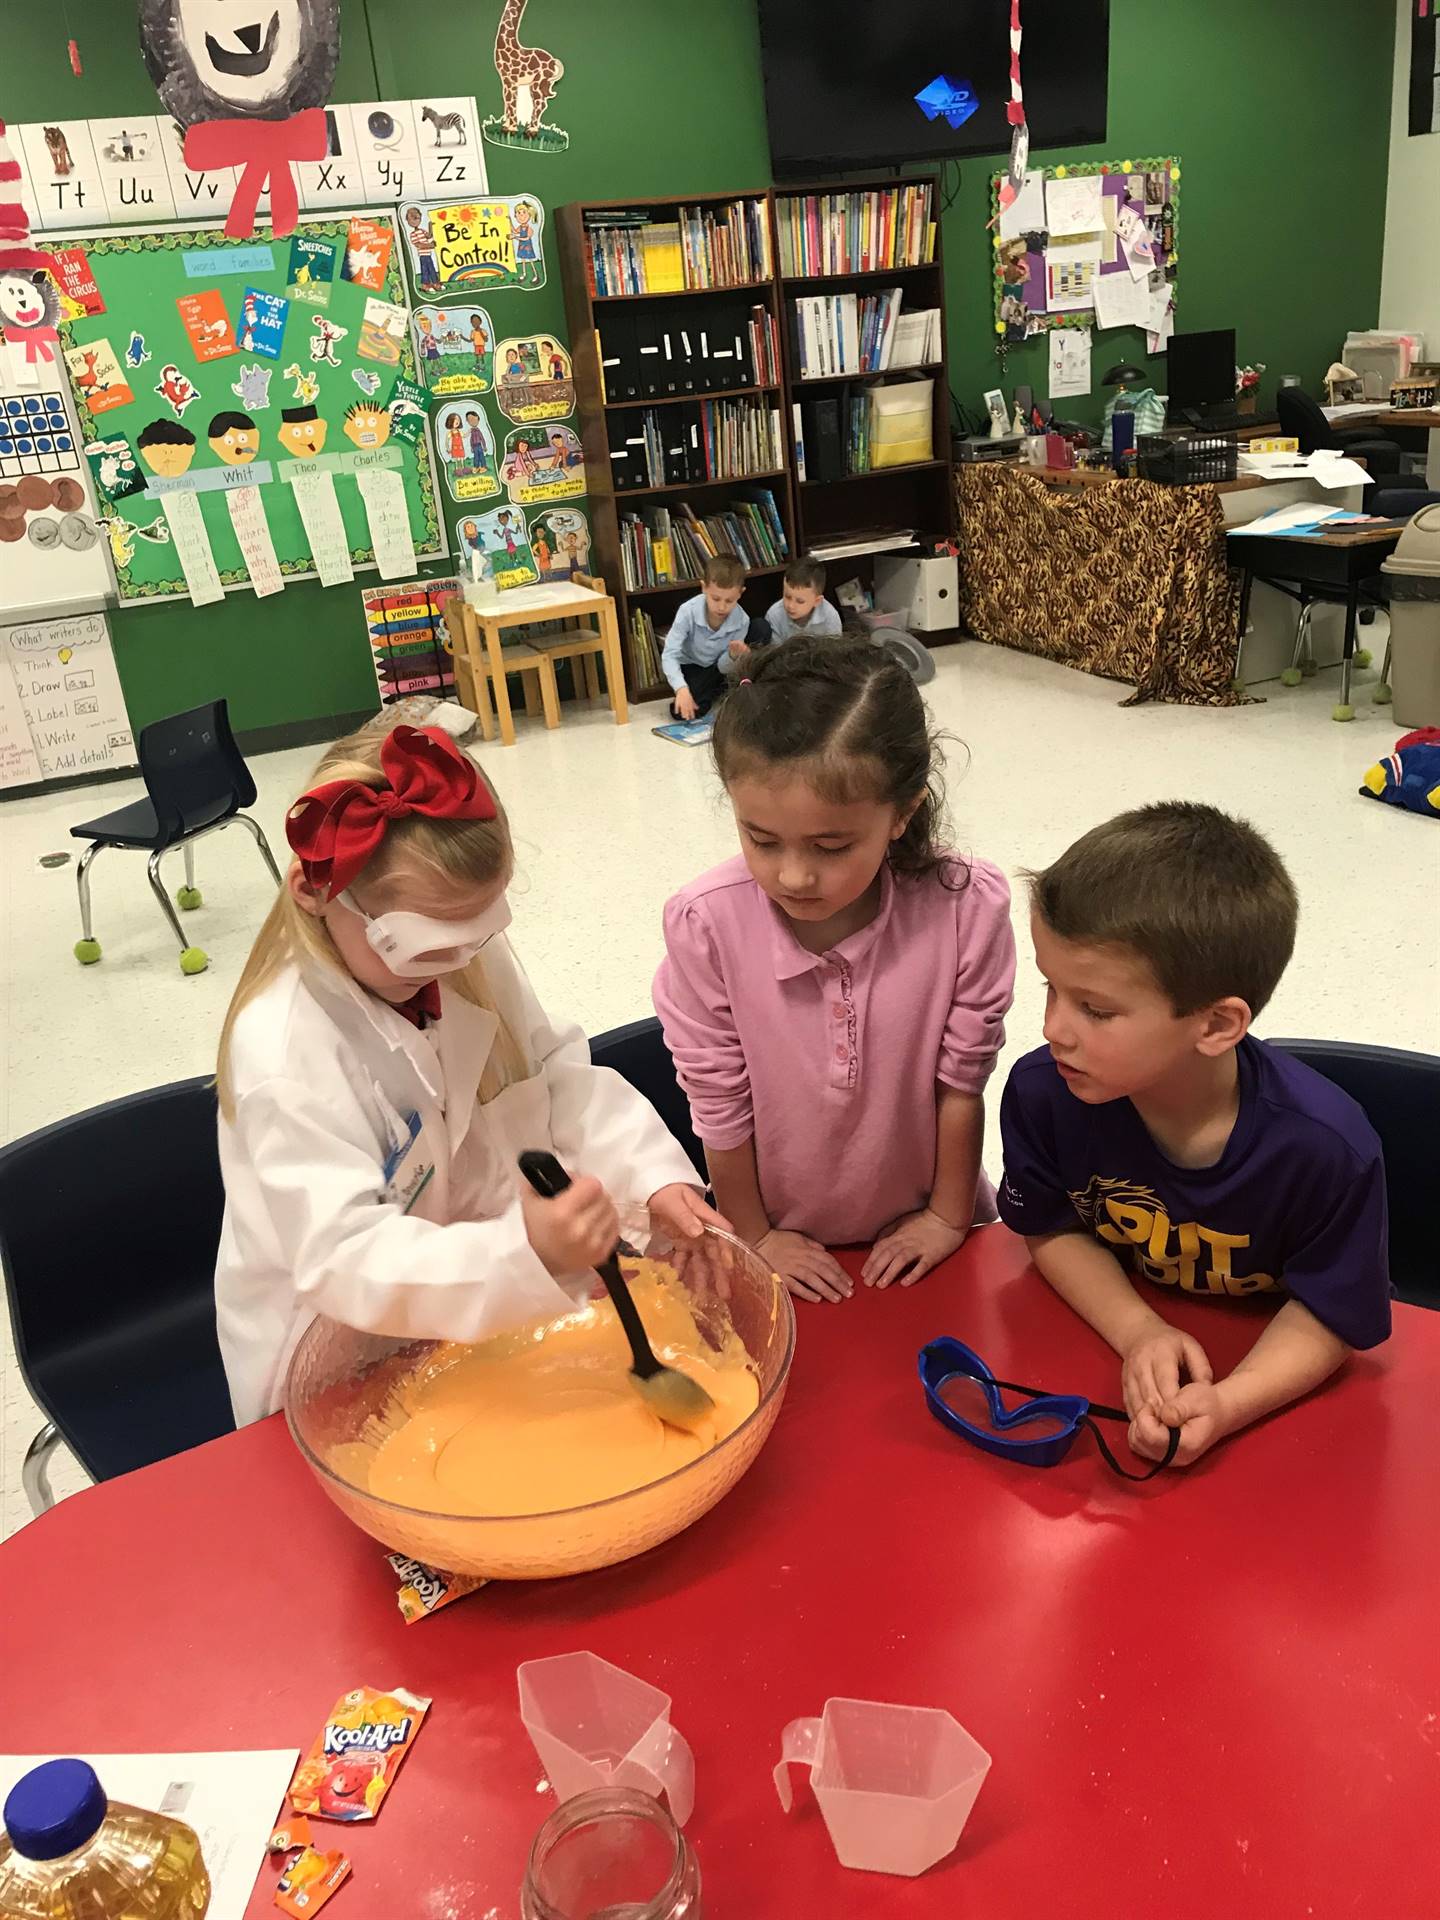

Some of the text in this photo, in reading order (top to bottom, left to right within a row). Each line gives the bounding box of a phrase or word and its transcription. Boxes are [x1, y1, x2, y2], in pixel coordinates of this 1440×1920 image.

[51, 155, 467, 210] Tt Uu Vv Xx Yy Zz
[442, 222, 500, 243] Be In
[54, 253, 70, 265] IF I
[440, 242, 509, 268] Control!
[63, 262, 82, 275] RAN
[63, 274, 81, 287] THE
[69, 281, 98, 299] CIRCUS
[265, 295, 286, 309] CAT
[260, 315, 284, 330] HAT
[96, 365, 116, 379] Socks
[353, 451, 391, 467] Charles
[223, 468, 254, 484] Whit
[457, 478, 494, 490] Be willing
[396, 597, 412, 606] red
[391, 608, 422, 619] yellow
[15, 621, 99, 647] What writers do
[393, 630, 427, 641] orange
[24, 660, 54, 672] Think
[31, 679, 61, 696] Draw
[408, 679, 429, 689] pink
[38, 703, 70, 723] Label
[44, 728, 78, 747] Write
[55, 756, 76, 771] Add
[79, 744, 114, 765] details
[324, 1718, 410, 1753] Kool-Aid
